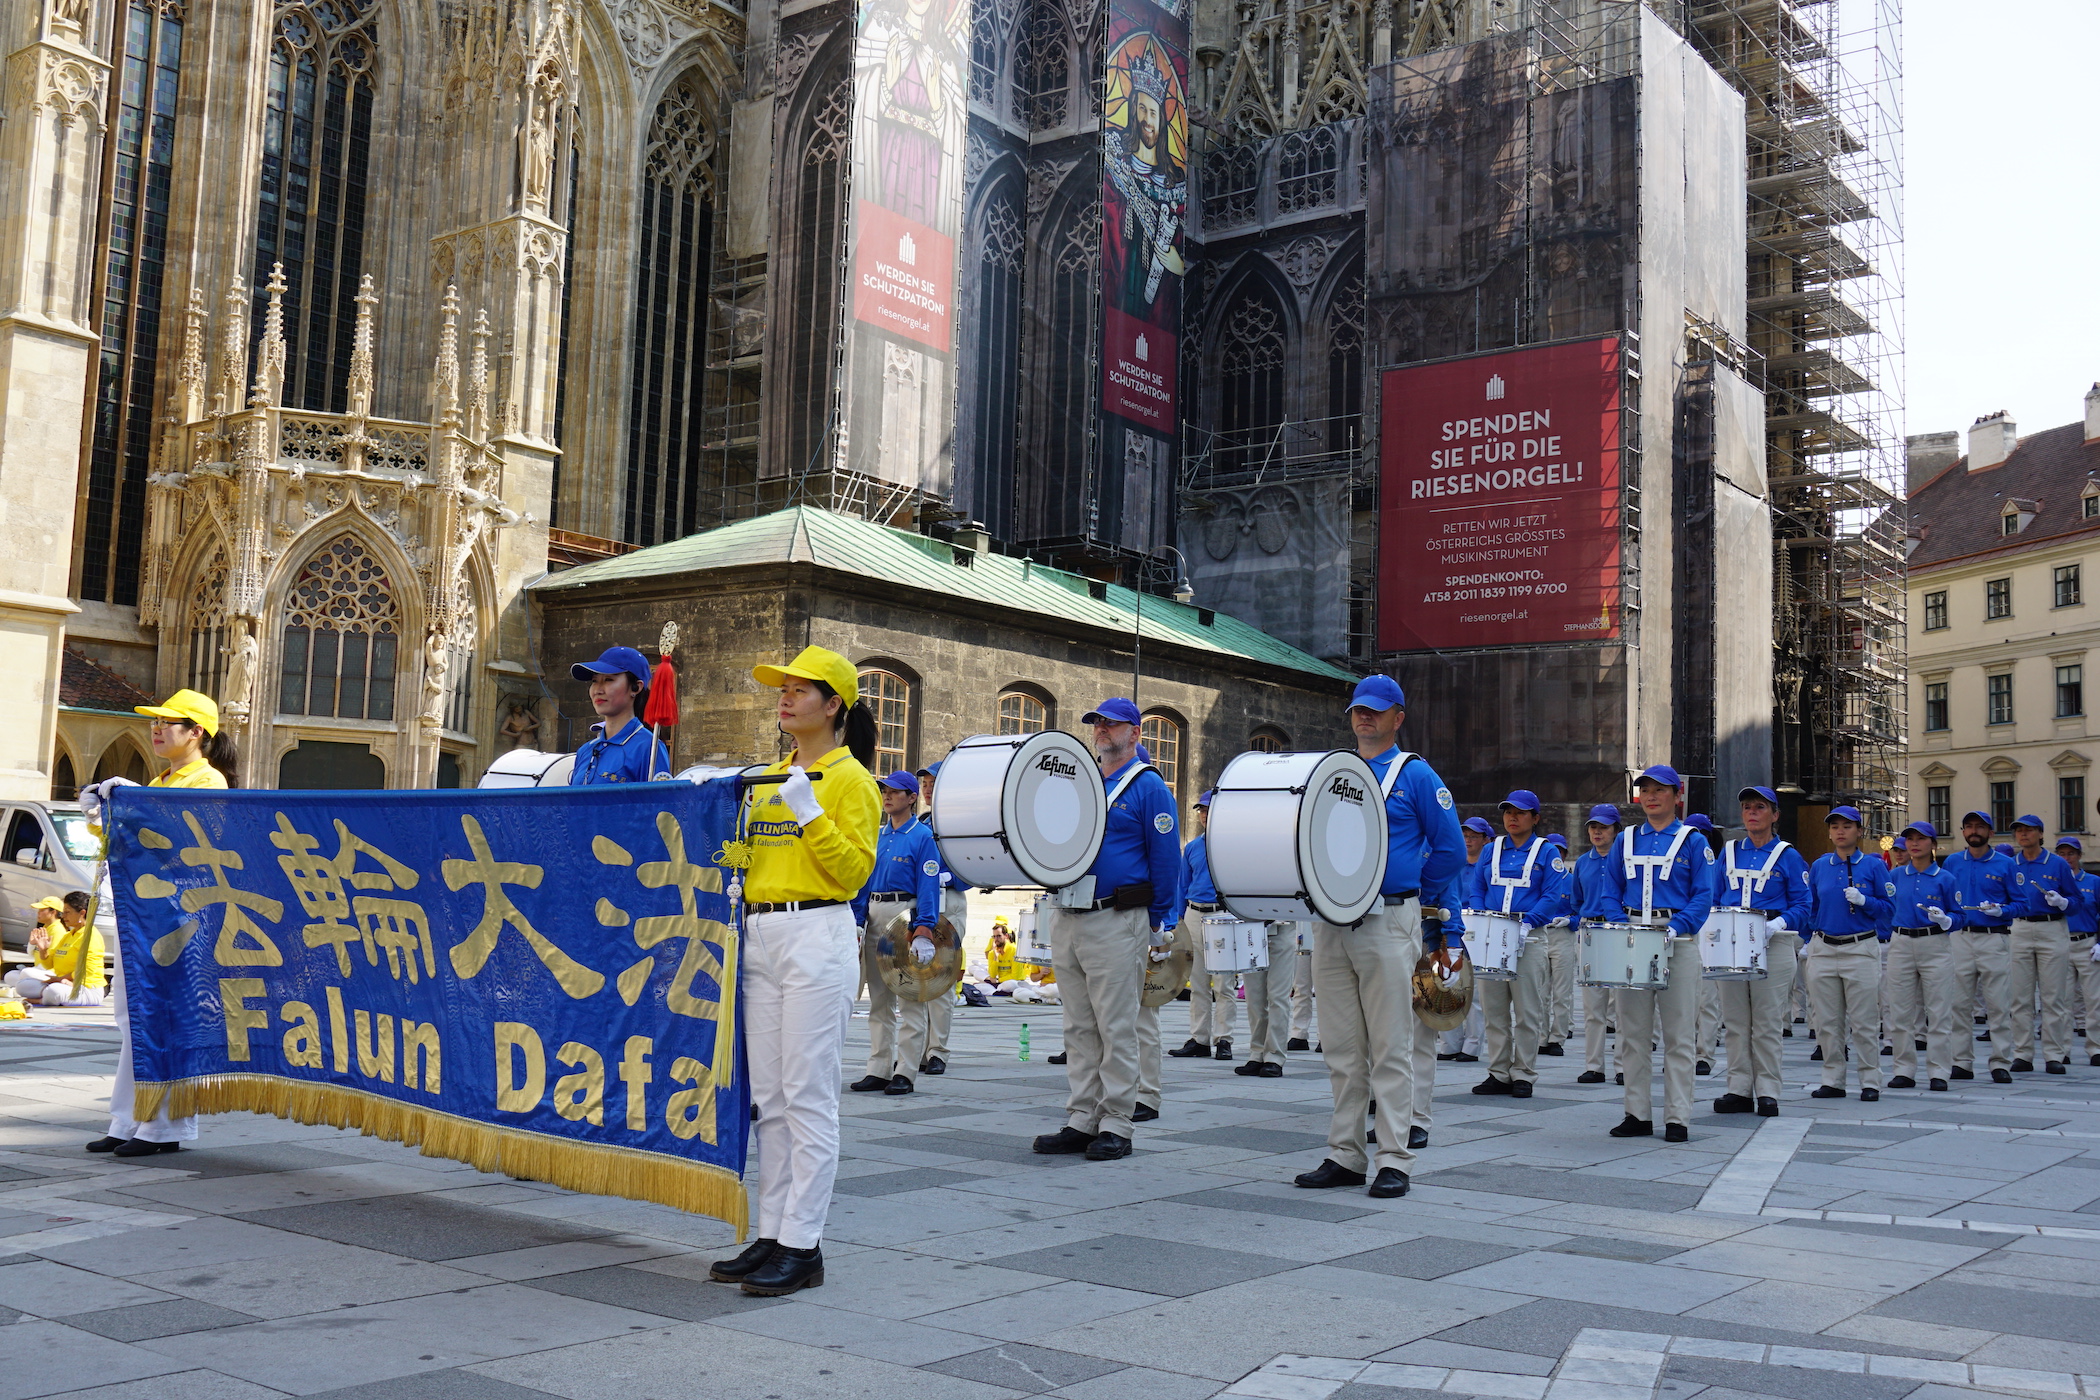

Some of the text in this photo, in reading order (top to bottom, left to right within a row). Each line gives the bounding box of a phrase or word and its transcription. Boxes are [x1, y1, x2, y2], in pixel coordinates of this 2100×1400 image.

[876, 261, 935, 295] WERDEN SIE
[863, 273, 944, 316] SCHUTZPATRON!
[878, 305, 930, 332] riesenorgel.at
[1118, 358, 1163, 386] WERDEN SIE
[1109, 370, 1171, 403] SCHUTZPATRON!
[1120, 396, 1159, 418] riesenorgel.at
[1441, 409, 1550, 441] SPENDEN
[1430, 436, 1561, 469] SIE FÜR DIE
[1411, 462, 1583, 499] RIESENORGEL!
[1443, 514, 1547, 534] RETTEN WIR JETZT
[1426, 528, 1566, 551] ÖSTERREICHS GRÖSSTES
[1441, 546, 1549, 565] MUSIKINSTRUMENT
[1445, 570, 1544, 587] SPENDENKONTO:
[1423, 582, 1567, 603] AT58 2011 1839 1199 6700
[1460, 609, 1528, 623] riesenorgel.at
[1563, 622, 1610, 631] STEPHANSDOM
[134, 811, 728, 1022] 法輪大法
[219, 978, 718, 1146] Falun Dafa
